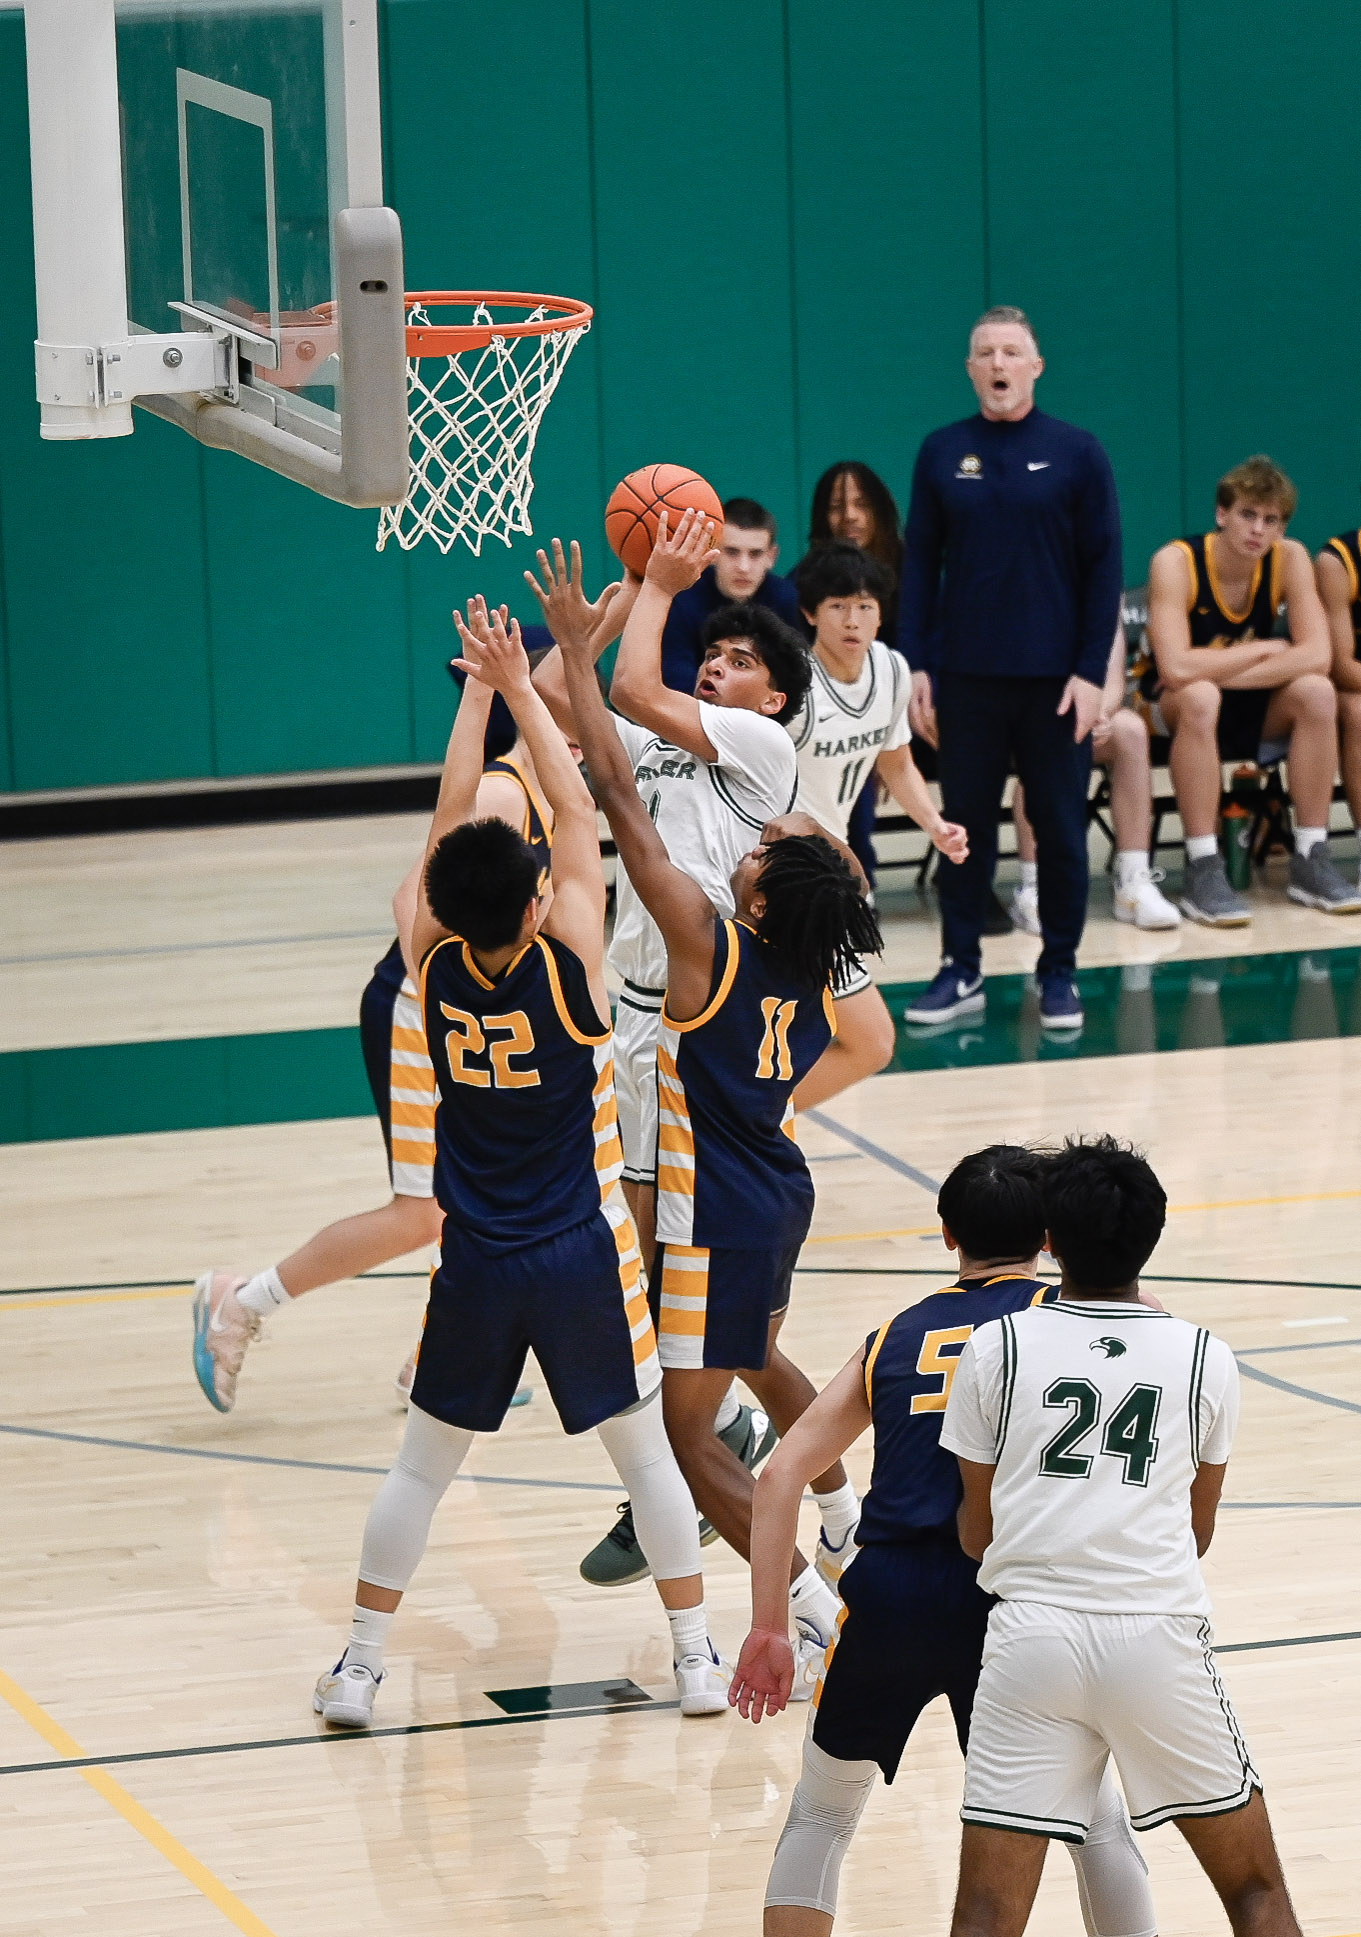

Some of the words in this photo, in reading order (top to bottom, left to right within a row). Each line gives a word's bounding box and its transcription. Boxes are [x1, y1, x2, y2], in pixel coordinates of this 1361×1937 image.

[837, 757, 866, 804] 11
[439, 1000, 541, 1088] 22
[755, 996, 798, 1080] 11
[910, 1324, 974, 1416] 5
[1038, 1376, 1163, 1488] 24
